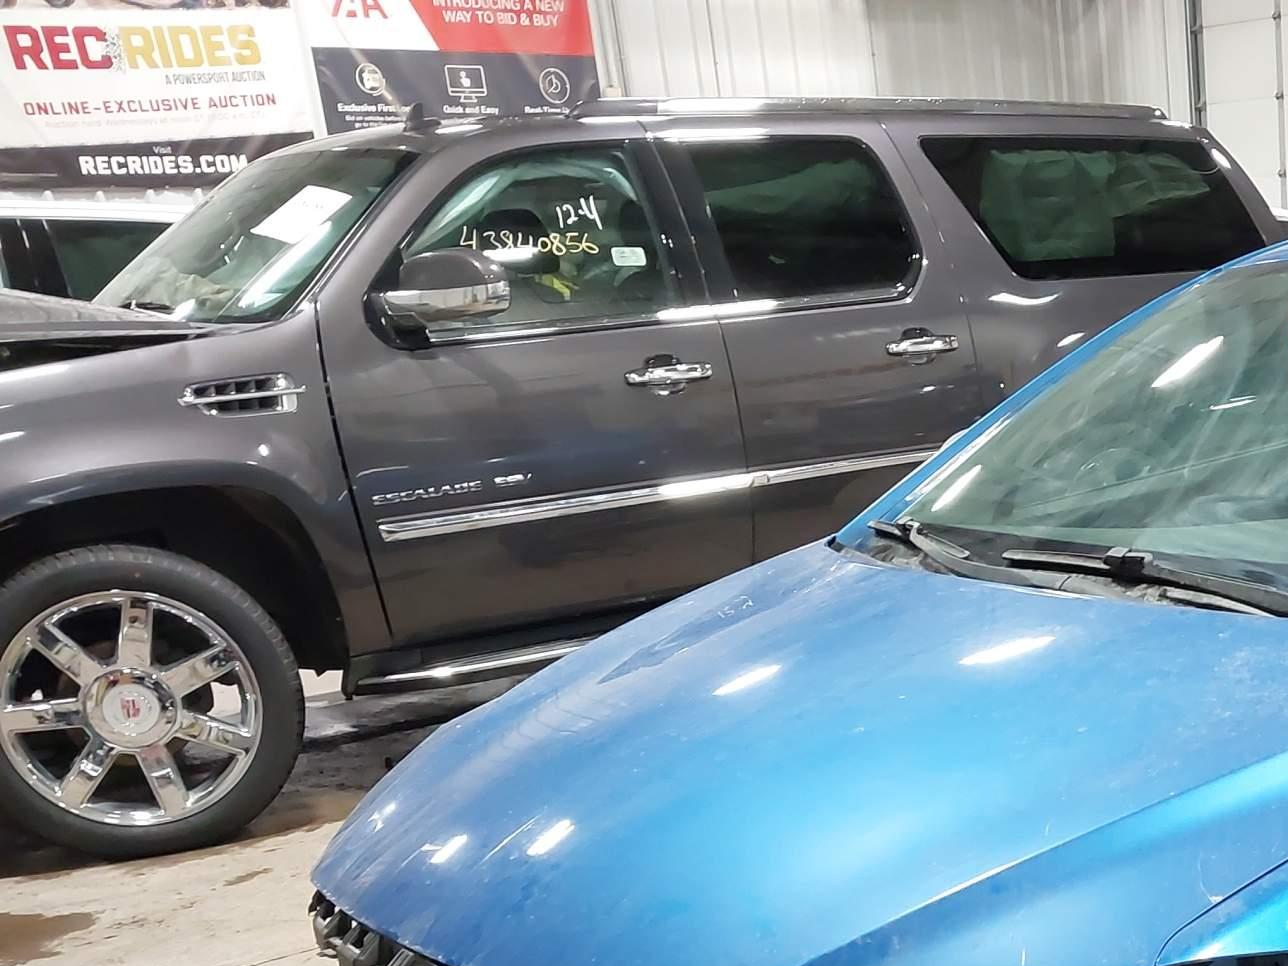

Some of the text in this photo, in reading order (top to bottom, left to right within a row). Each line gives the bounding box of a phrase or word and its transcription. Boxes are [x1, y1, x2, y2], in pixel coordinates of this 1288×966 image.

[536, 0, 565, 12] NEW
[442, 10, 559, 27] WAY TO BID & BUY
[118, 24, 262, 69] RIDES
[165, 71, 266, 85] A POWERSPORT AUCTION
[23, 93, 277, 116] ONLINE-EXCLUSIVE AUCTION
[337, 103, 376, 112] Exclusive
[443, 105, 499, 115] Quick and Easy
[152, 145, 172, 154] Visit
[78, 154, 248, 175] RECRIDES.COM
